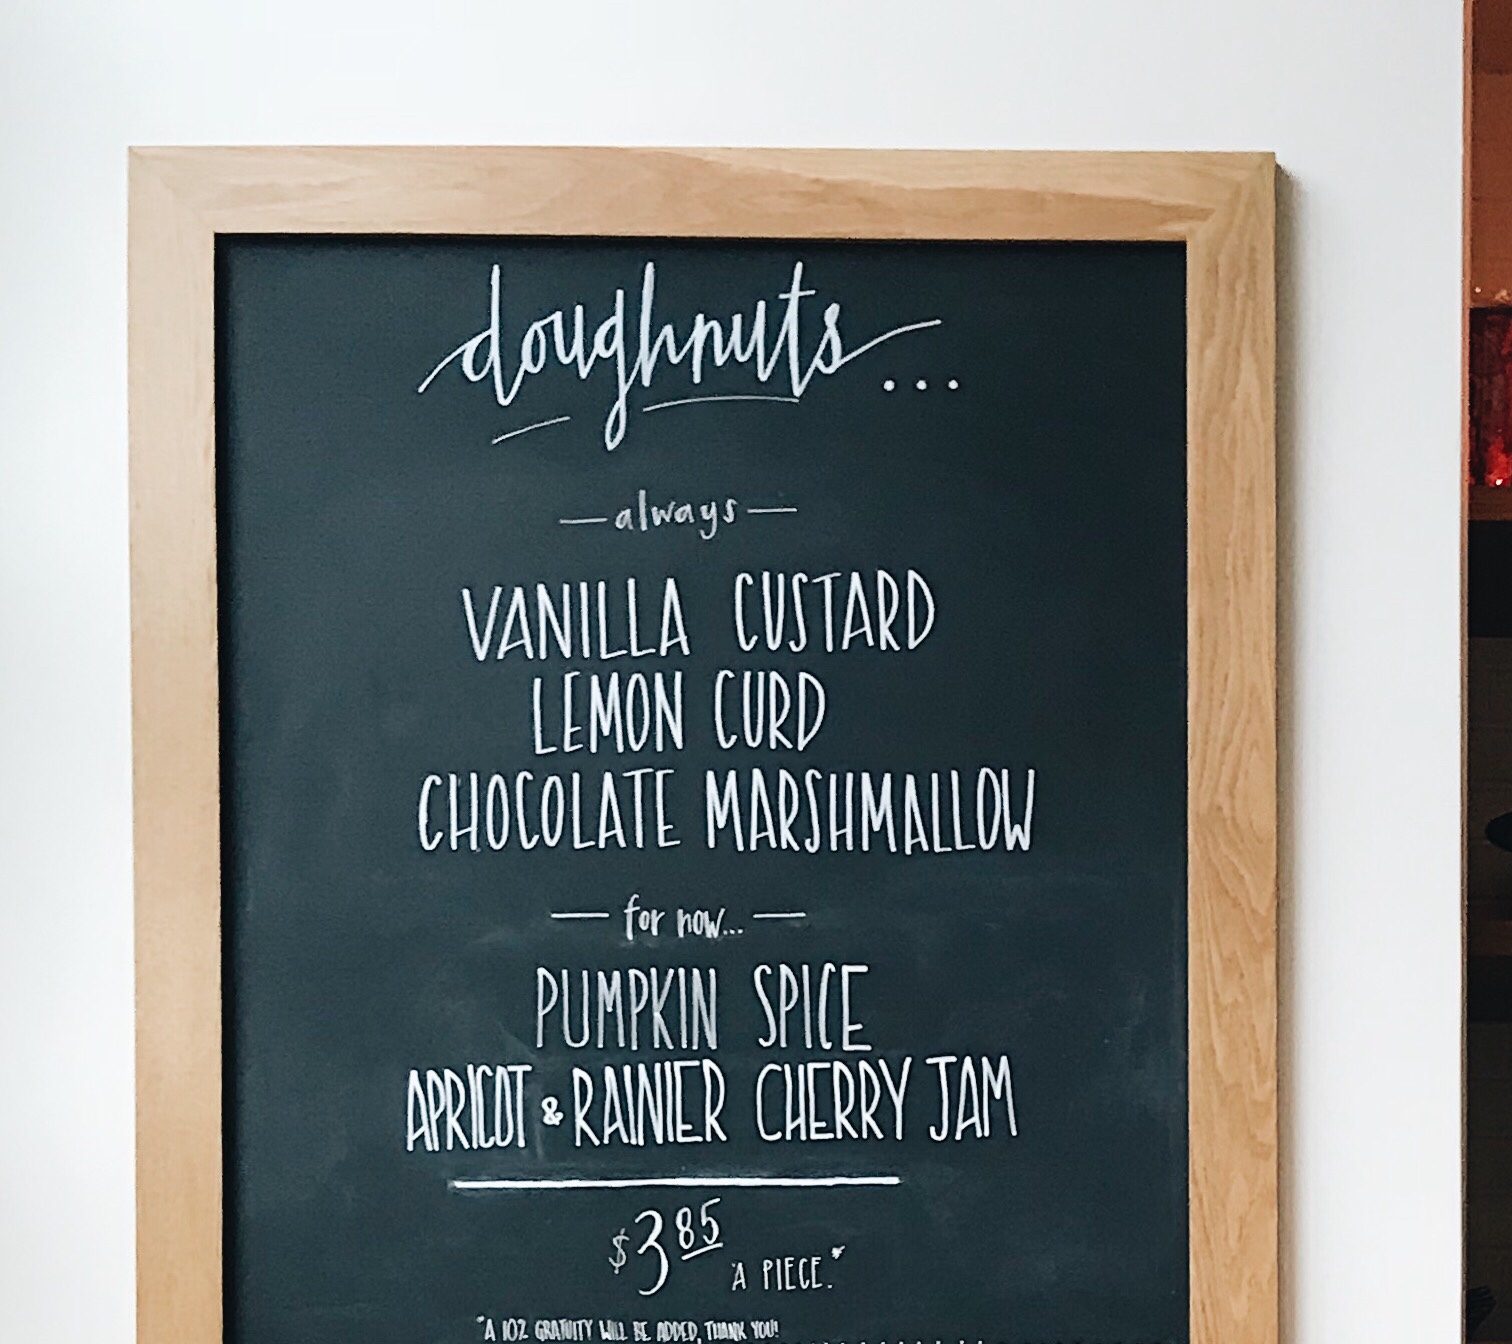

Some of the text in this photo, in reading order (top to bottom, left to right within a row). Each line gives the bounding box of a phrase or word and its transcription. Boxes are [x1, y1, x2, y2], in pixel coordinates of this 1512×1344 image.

[614, 489, 737, 540] always
[462, 569, 935, 661] VANILLA CUSTARD
[533, 669, 826, 755] LEMON CURD
[418, 767, 1035, 855] CHOCOLATE MARSHMALLOW
[623, 893, 666, 941] for
[536, 962, 872, 1051] PUMPKIN SPICE
[406, 1055, 1018, 1152] APRICOT & RAINIER CHERRY JAM
[732, 1262, 747, 1291] A
[534, 1318, 594, 1342] GRATUITY
[599, 1319, 629, 1341] WILL
[632, 1320, 652, 1342] BE
[704, 1320, 748, 1342] THANK
[750, 1318, 780, 1340] YOU!
